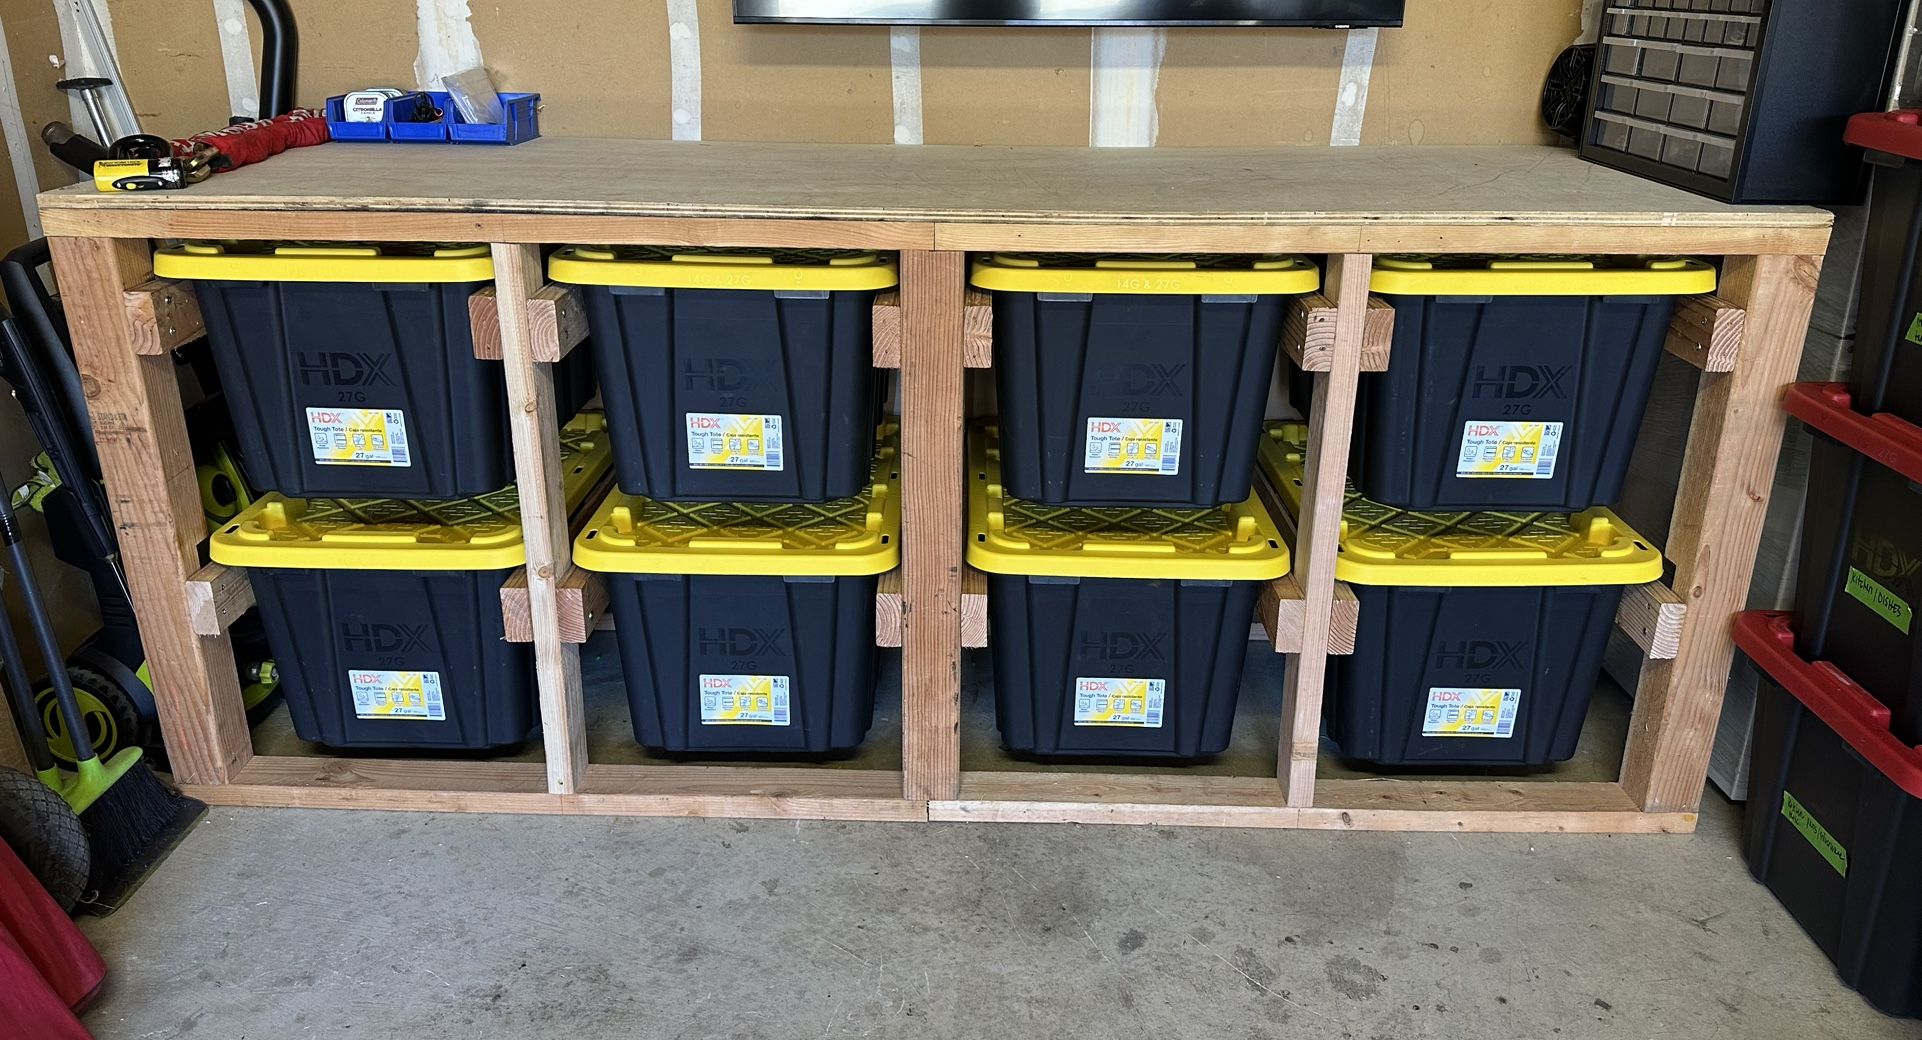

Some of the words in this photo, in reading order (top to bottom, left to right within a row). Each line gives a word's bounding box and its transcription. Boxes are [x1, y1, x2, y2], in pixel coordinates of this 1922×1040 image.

[727, 275, 752, 285] 27G
[1117, 279, 1140, 290] 14G
[1143, 280, 1151, 289] &
[1156, 280, 1181, 290] 27G
[297, 351, 397, 386] HDX
[1472, 365, 1573, 399] HDX
[337, 391, 367, 402] 27G
[1122, 402, 1151, 412] 27G
[1503, 404, 1532, 415] 27G
[310, 412, 343, 424] HDX
[690, 417, 720, 429] HDX
[1091, 421, 1121, 433] HDX
[1468, 425, 1499, 436] HDX
[342, 623, 432, 652] HDX
[699, 627, 786, 657] HDX
[1080, 631, 1167, 660] HDX
[1435, 640, 1527, 670] HDX
[379, 657, 405, 666] 27G
[731, 660, 757, 671] 27G
[353, 674, 383, 684] HDX
[703, 678, 732, 688] HDX
[1080, 681, 1108, 691] HDX
[1432, 692, 1461, 701] HDX
